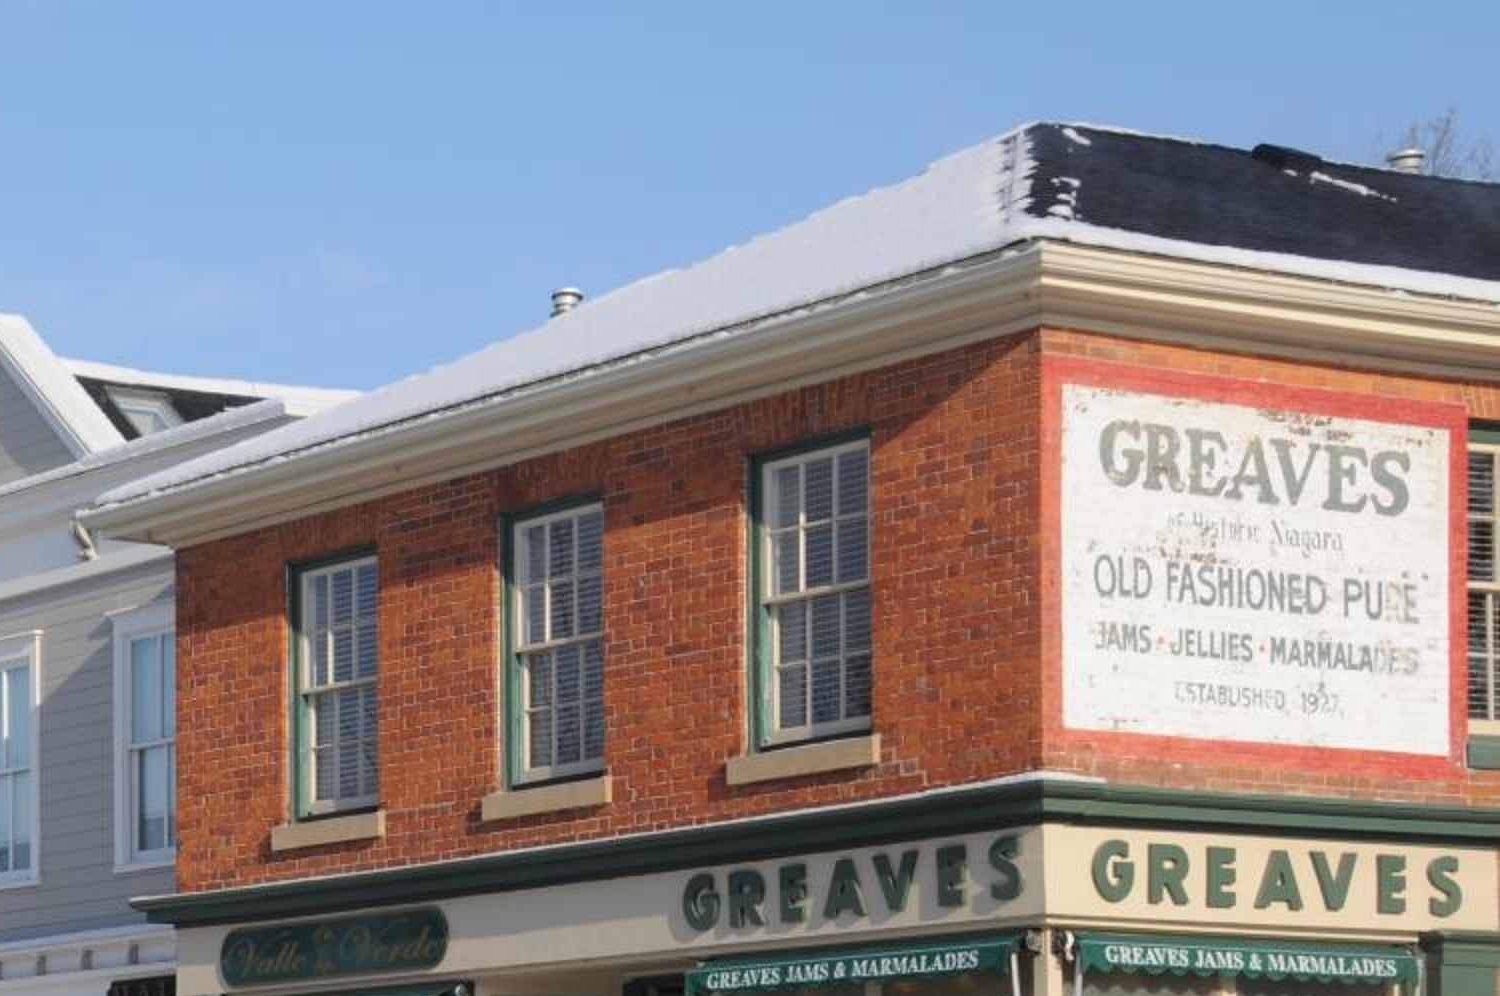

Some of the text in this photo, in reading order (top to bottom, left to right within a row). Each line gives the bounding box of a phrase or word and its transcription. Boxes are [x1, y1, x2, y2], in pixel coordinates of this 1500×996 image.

[1099, 420, 1412, 517] GREAVES
[1271, 519, 1345, 558] Niagara
[1094, 553, 1152, 599] OLD
[1167, 560, 1326, 615] FASHIONED
[1170, 629, 1253, 663] JELLIES
[683, 834, 1023, 932] GREAVES
[1091, 839, 1463, 917] GREAVES
[706, 949, 980, 990] GREAVES JAMS & MARMALADES
[1105, 945, 1397, 978] GREAVES JAMS & MARMALADES
